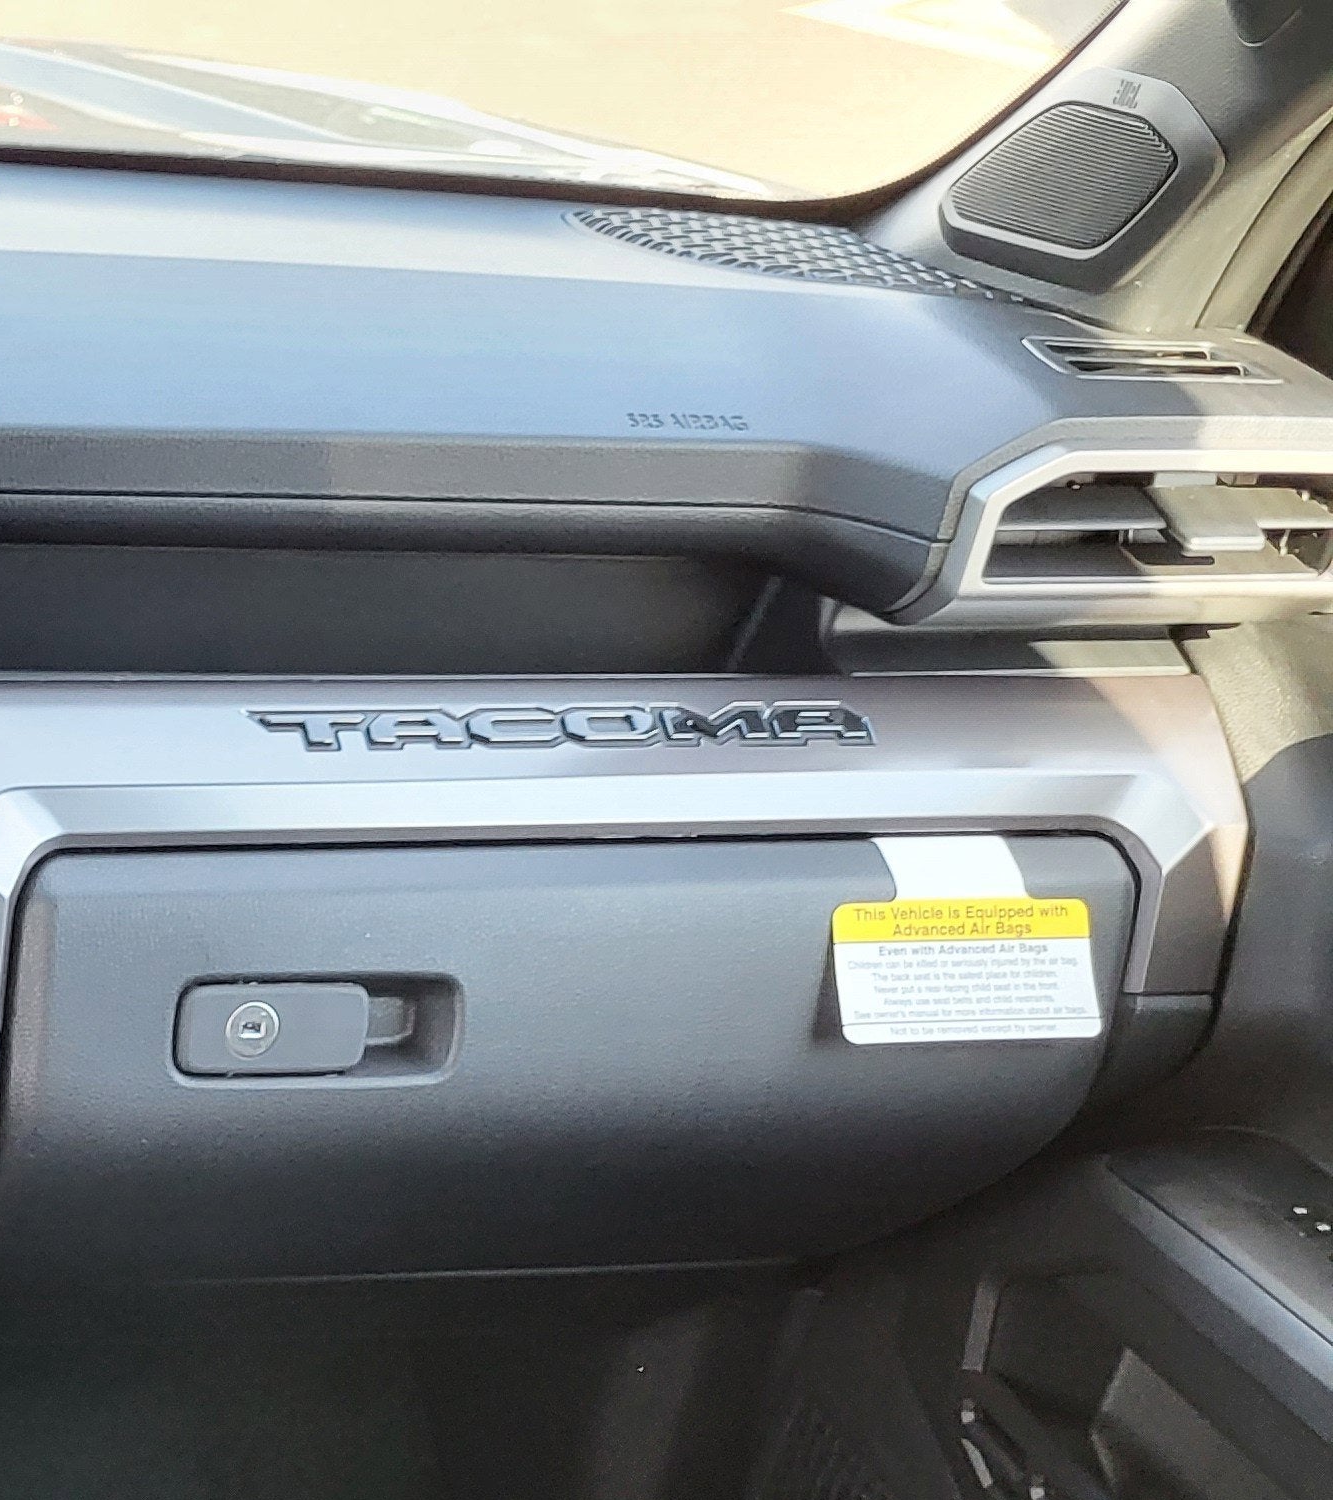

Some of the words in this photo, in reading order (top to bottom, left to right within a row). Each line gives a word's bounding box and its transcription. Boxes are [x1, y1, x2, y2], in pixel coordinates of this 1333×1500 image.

[241, 700, 877, 751] TACOMA
[854, 908, 885, 921] This
[891, 907, 943, 920] Vehicle
[965, 905, 1034, 920] Equipped
[1039, 905, 1068, 917] with
[893, 922, 965, 936] Advanced
[970, 922, 990, 935] Air
[995, 921, 1032, 938] Bags
[879, 946, 907, 956] Even
[911, 945, 934, 955] with
[939, 944, 995, 955] Advanced
[999, 943, 1015, 953] Air
[1019, 943, 1048, 955] Bags
